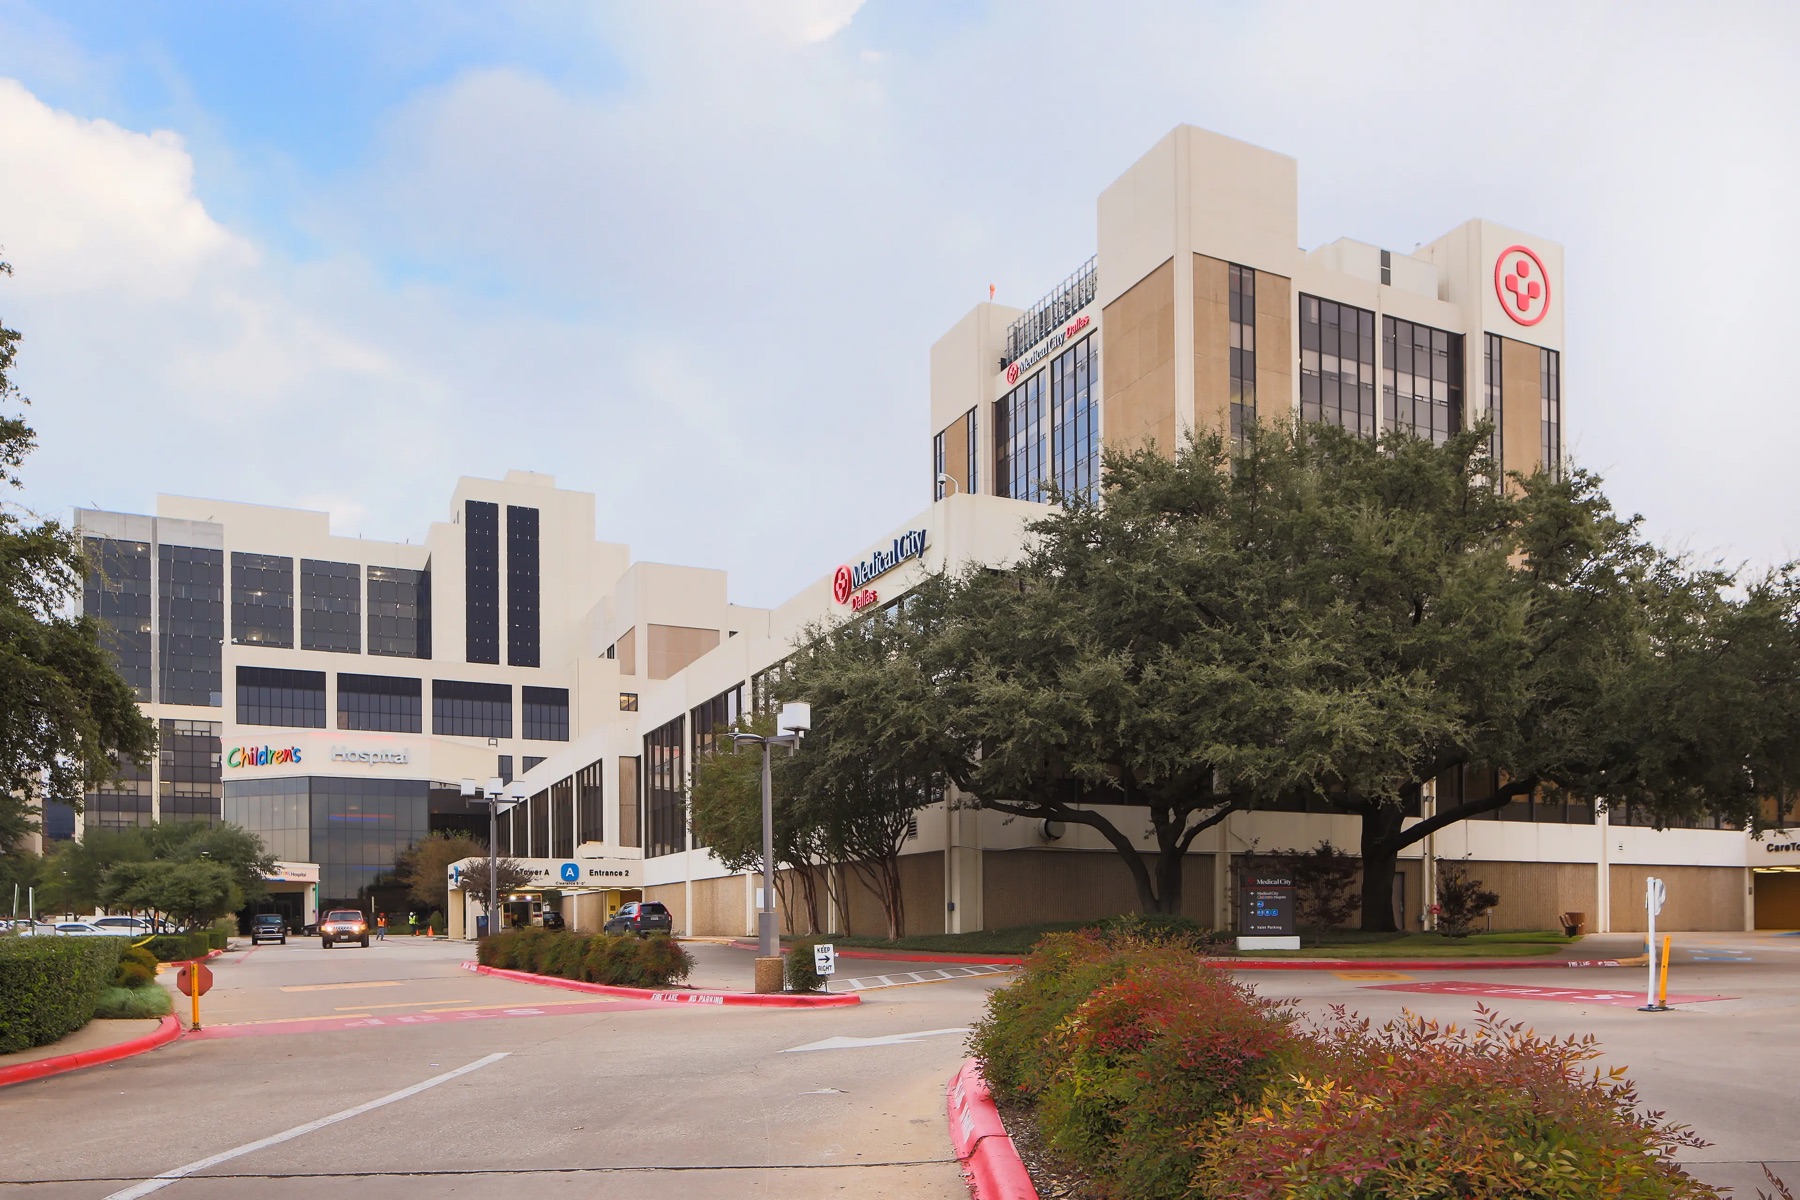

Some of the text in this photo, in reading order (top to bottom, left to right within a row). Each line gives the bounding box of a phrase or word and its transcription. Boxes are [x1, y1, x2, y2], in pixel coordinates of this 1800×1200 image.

[1019, 316, 1089, 374] Medical City Dallas
[852, 529, 927, 589] Medical City
[852, 589, 877, 612] Dallas
[227, 745, 409, 768] Children's Hospital
[544, 868, 550, 876] A
[565, 867, 575, 877] A
[589, 869, 630, 877] Entrance 2
